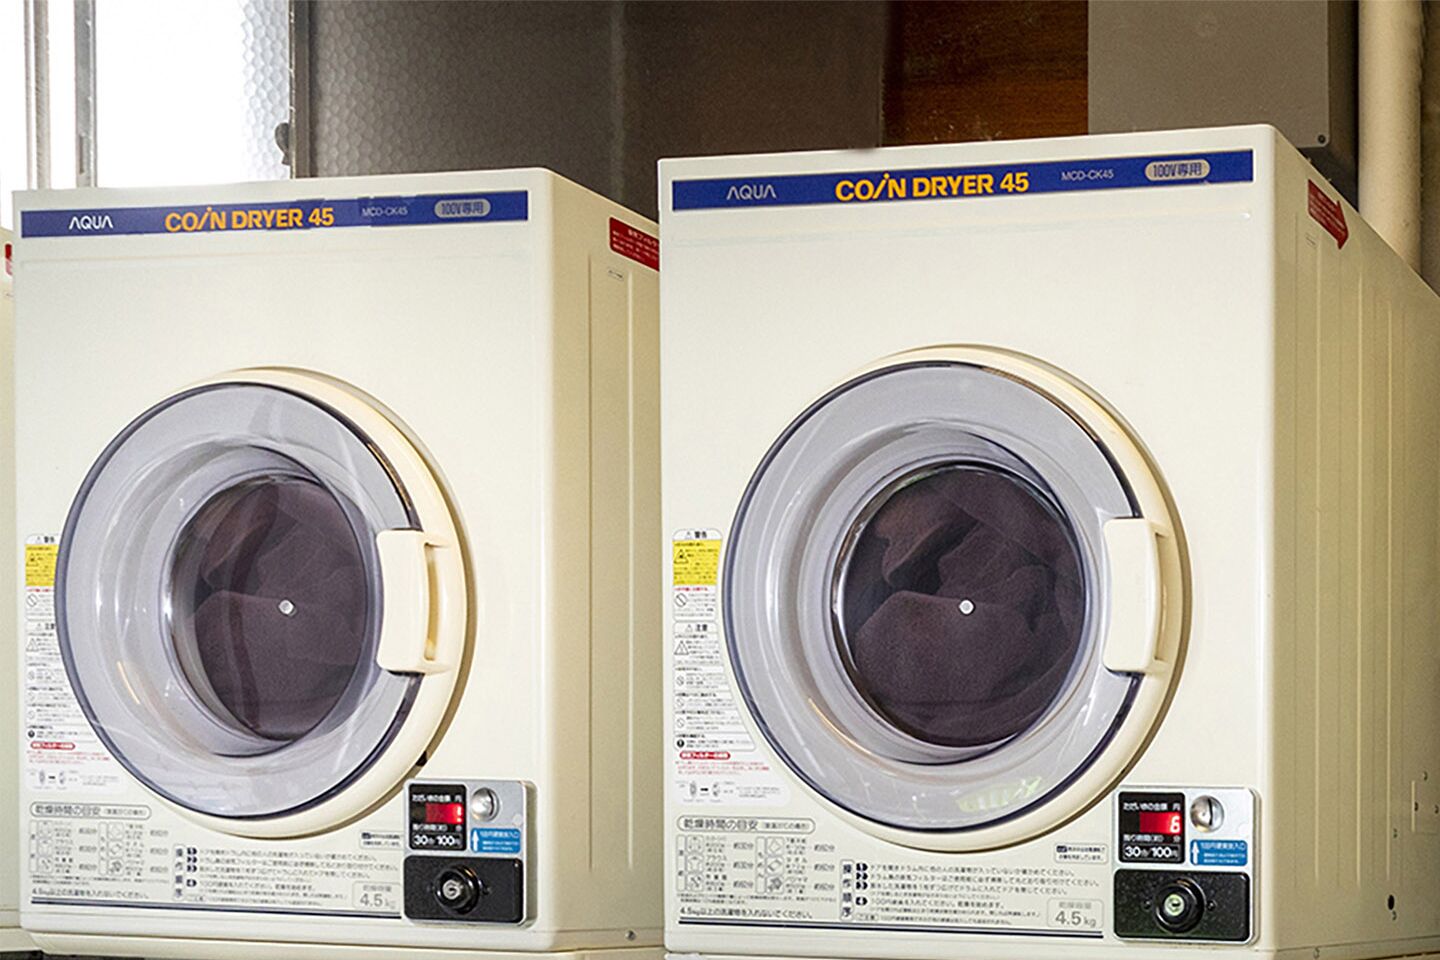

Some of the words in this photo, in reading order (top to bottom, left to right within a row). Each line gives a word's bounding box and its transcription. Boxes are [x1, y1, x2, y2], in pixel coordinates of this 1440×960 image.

[1061, 168, 1114, 182] MCD-CK45
[727, 184, 777, 200] AQUA
[912, 173, 993, 198] DRYER
[1000, 172, 1030, 193] 45
[69, 215, 114, 231] AQUA
[231, 208, 303, 230] DRYER
[308, 207, 335, 228] 45
[1169, 815, 1181, 834] 6
[360, 893, 384, 908] 4.5
[1055, 911, 1082, 925] 4.5
